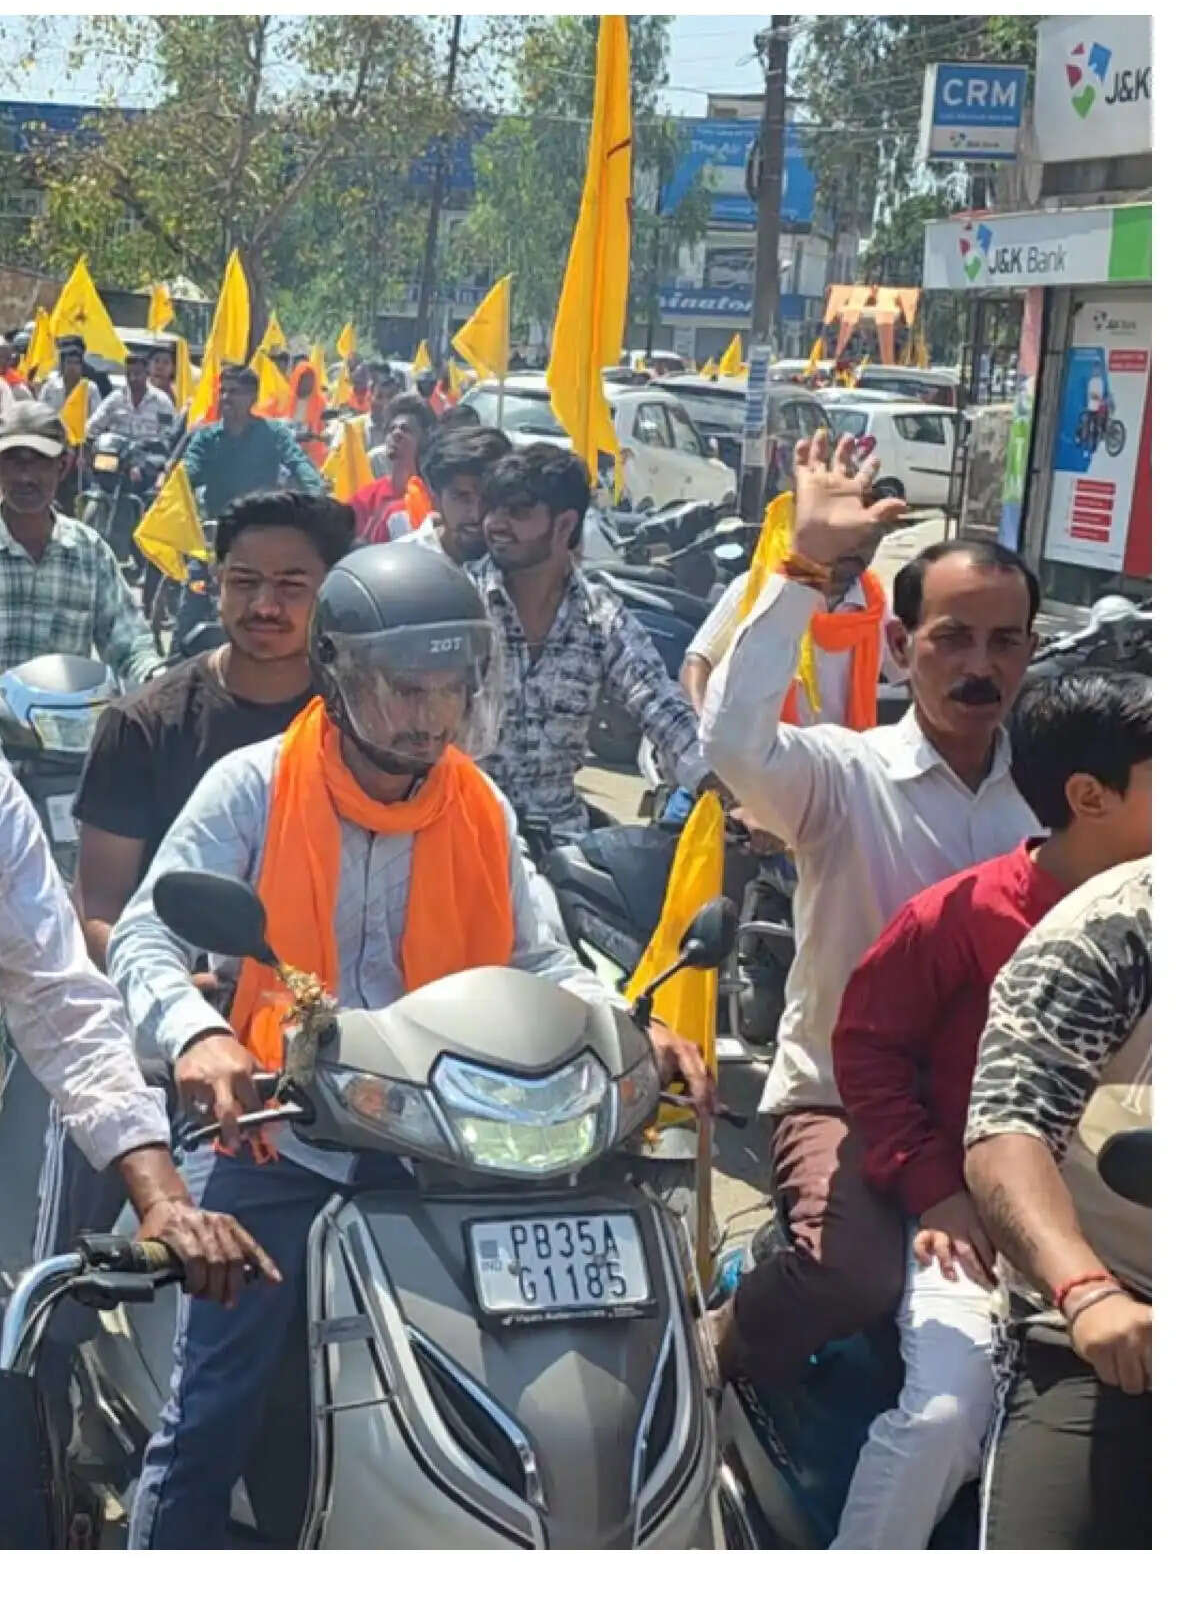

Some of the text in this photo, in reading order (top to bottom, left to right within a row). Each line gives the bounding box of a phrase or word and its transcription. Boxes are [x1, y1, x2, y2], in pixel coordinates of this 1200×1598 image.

[942, 78, 1017, 107] CRM
[988, 243, 1067, 275] J&K Bank
[510, 1219, 619, 1263] PB35A
[518, 1260, 627, 1302] G1185
